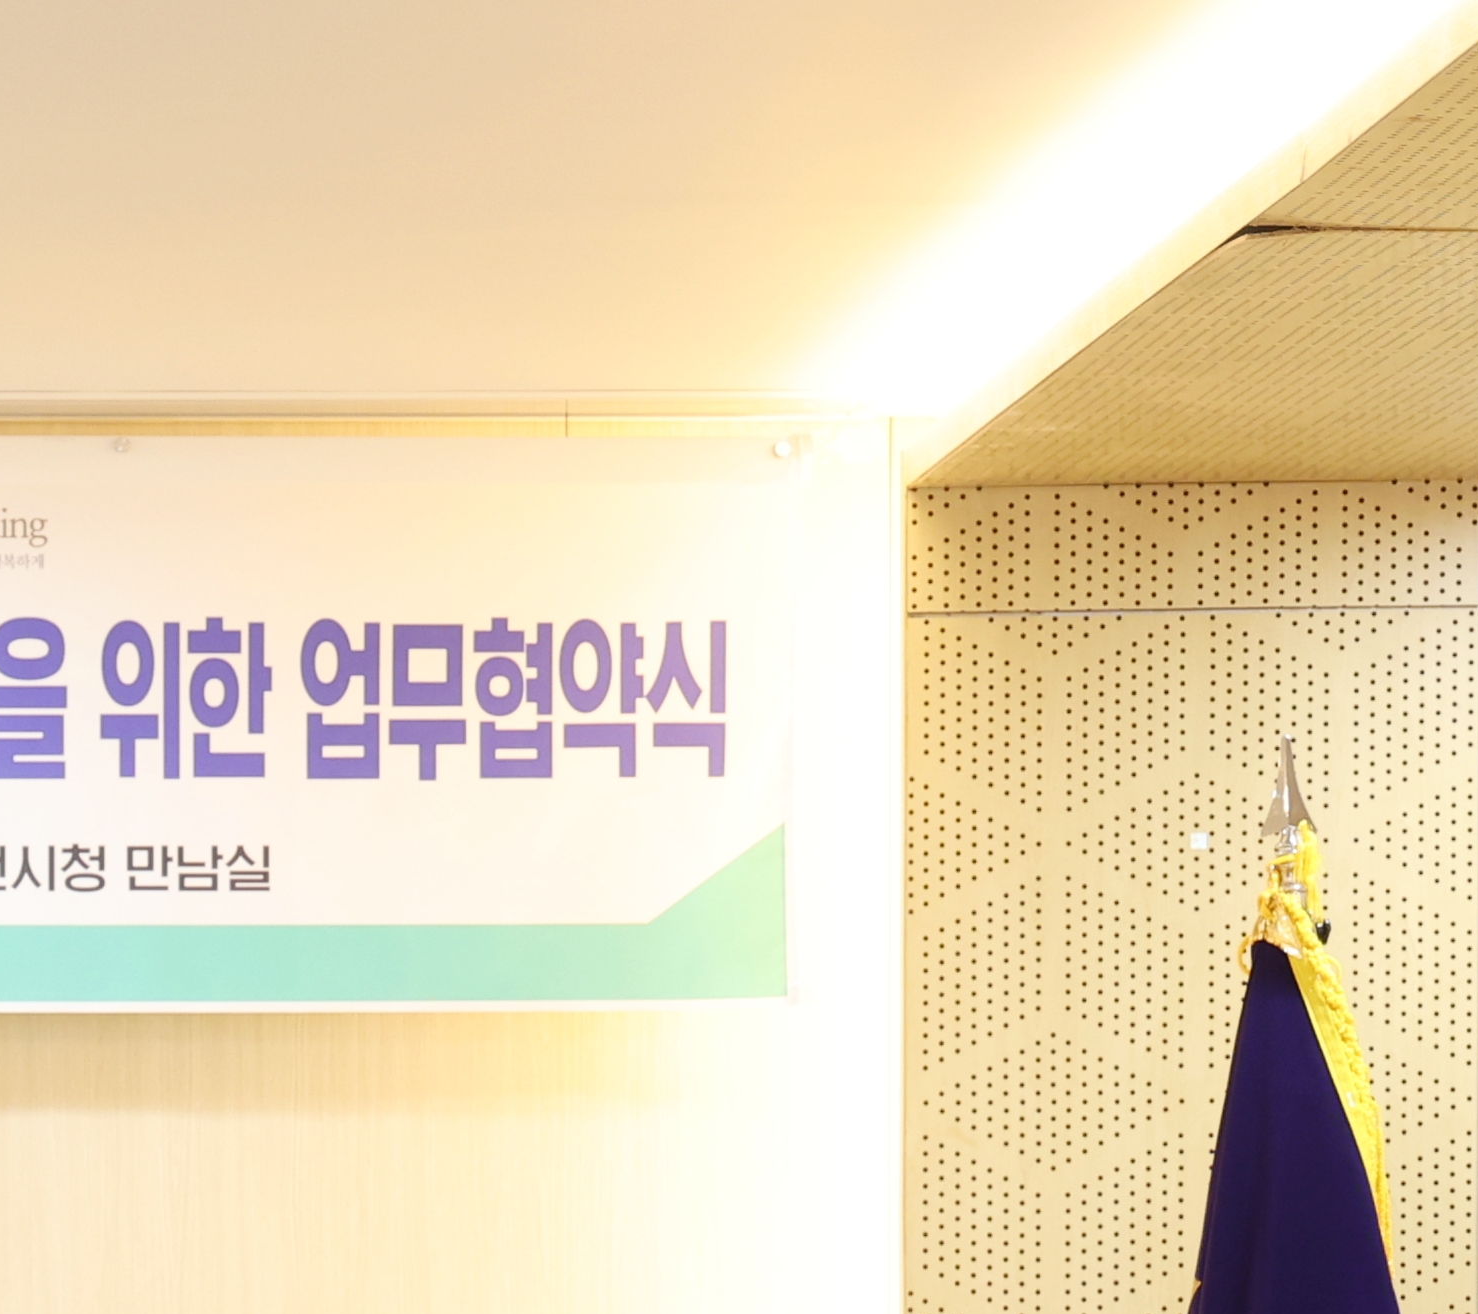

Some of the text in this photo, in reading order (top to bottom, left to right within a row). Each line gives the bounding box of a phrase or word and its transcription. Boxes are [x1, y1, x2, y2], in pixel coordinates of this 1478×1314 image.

[99, 616, 273, 780] 위한
[299, 616, 727, 781] 업무협약식
[125, 842, 272, 894] 만남실
